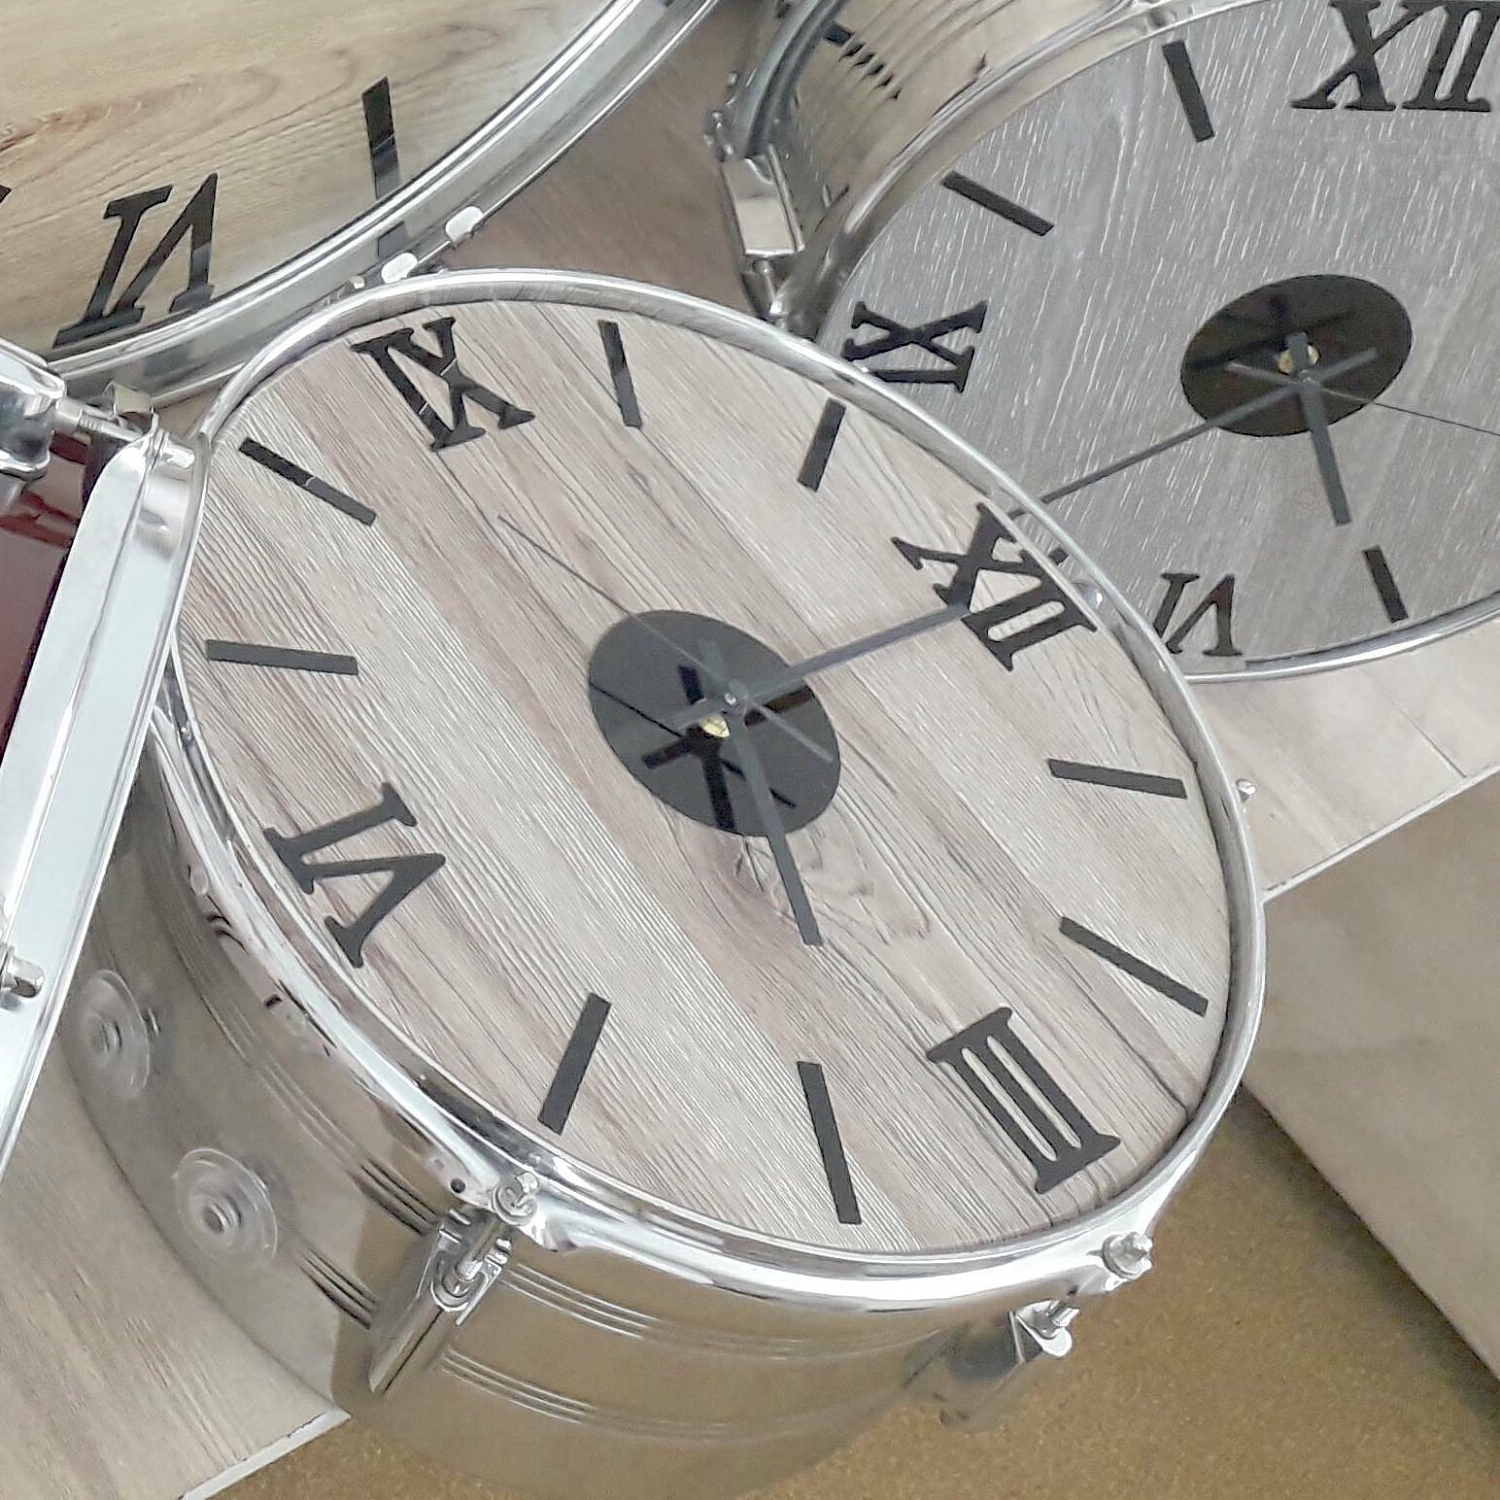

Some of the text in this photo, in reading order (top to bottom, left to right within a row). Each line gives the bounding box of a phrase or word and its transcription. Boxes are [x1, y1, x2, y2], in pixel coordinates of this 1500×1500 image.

[53, 173, 219, 348] VI
[350, 317, 535, 452] IX
[842, 301, 988, 394] IX
[891, 503, 1097, 671] XII
[1152, 573, 1243, 657] VI
[262, 781, 446, 969] VI
[926, 1006, 1122, 1194] III
